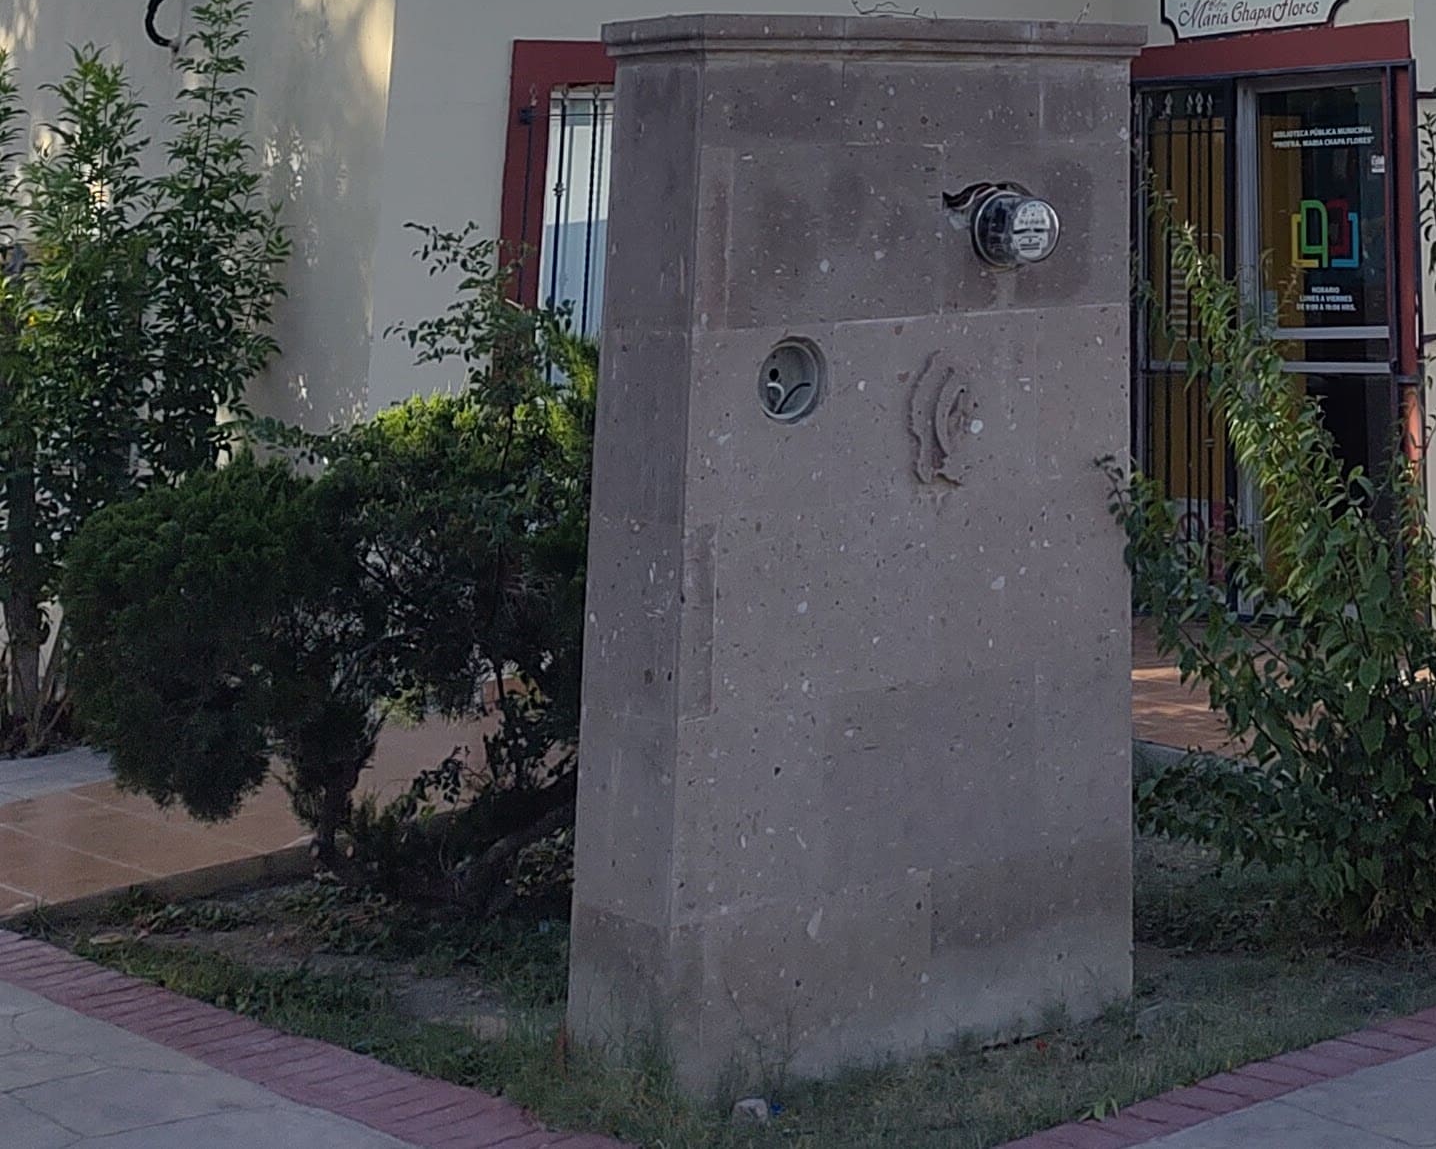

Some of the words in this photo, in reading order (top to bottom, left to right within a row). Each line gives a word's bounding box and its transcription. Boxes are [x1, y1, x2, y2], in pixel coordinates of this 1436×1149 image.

[1231, 2, 1275, 26] Chapa
[1273, 130, 1308, 138] BIBLIOTECA
[1309, 127, 1336, 136] PÚBLICA
[1337, 126, 1372, 134] MUNICIPAL
